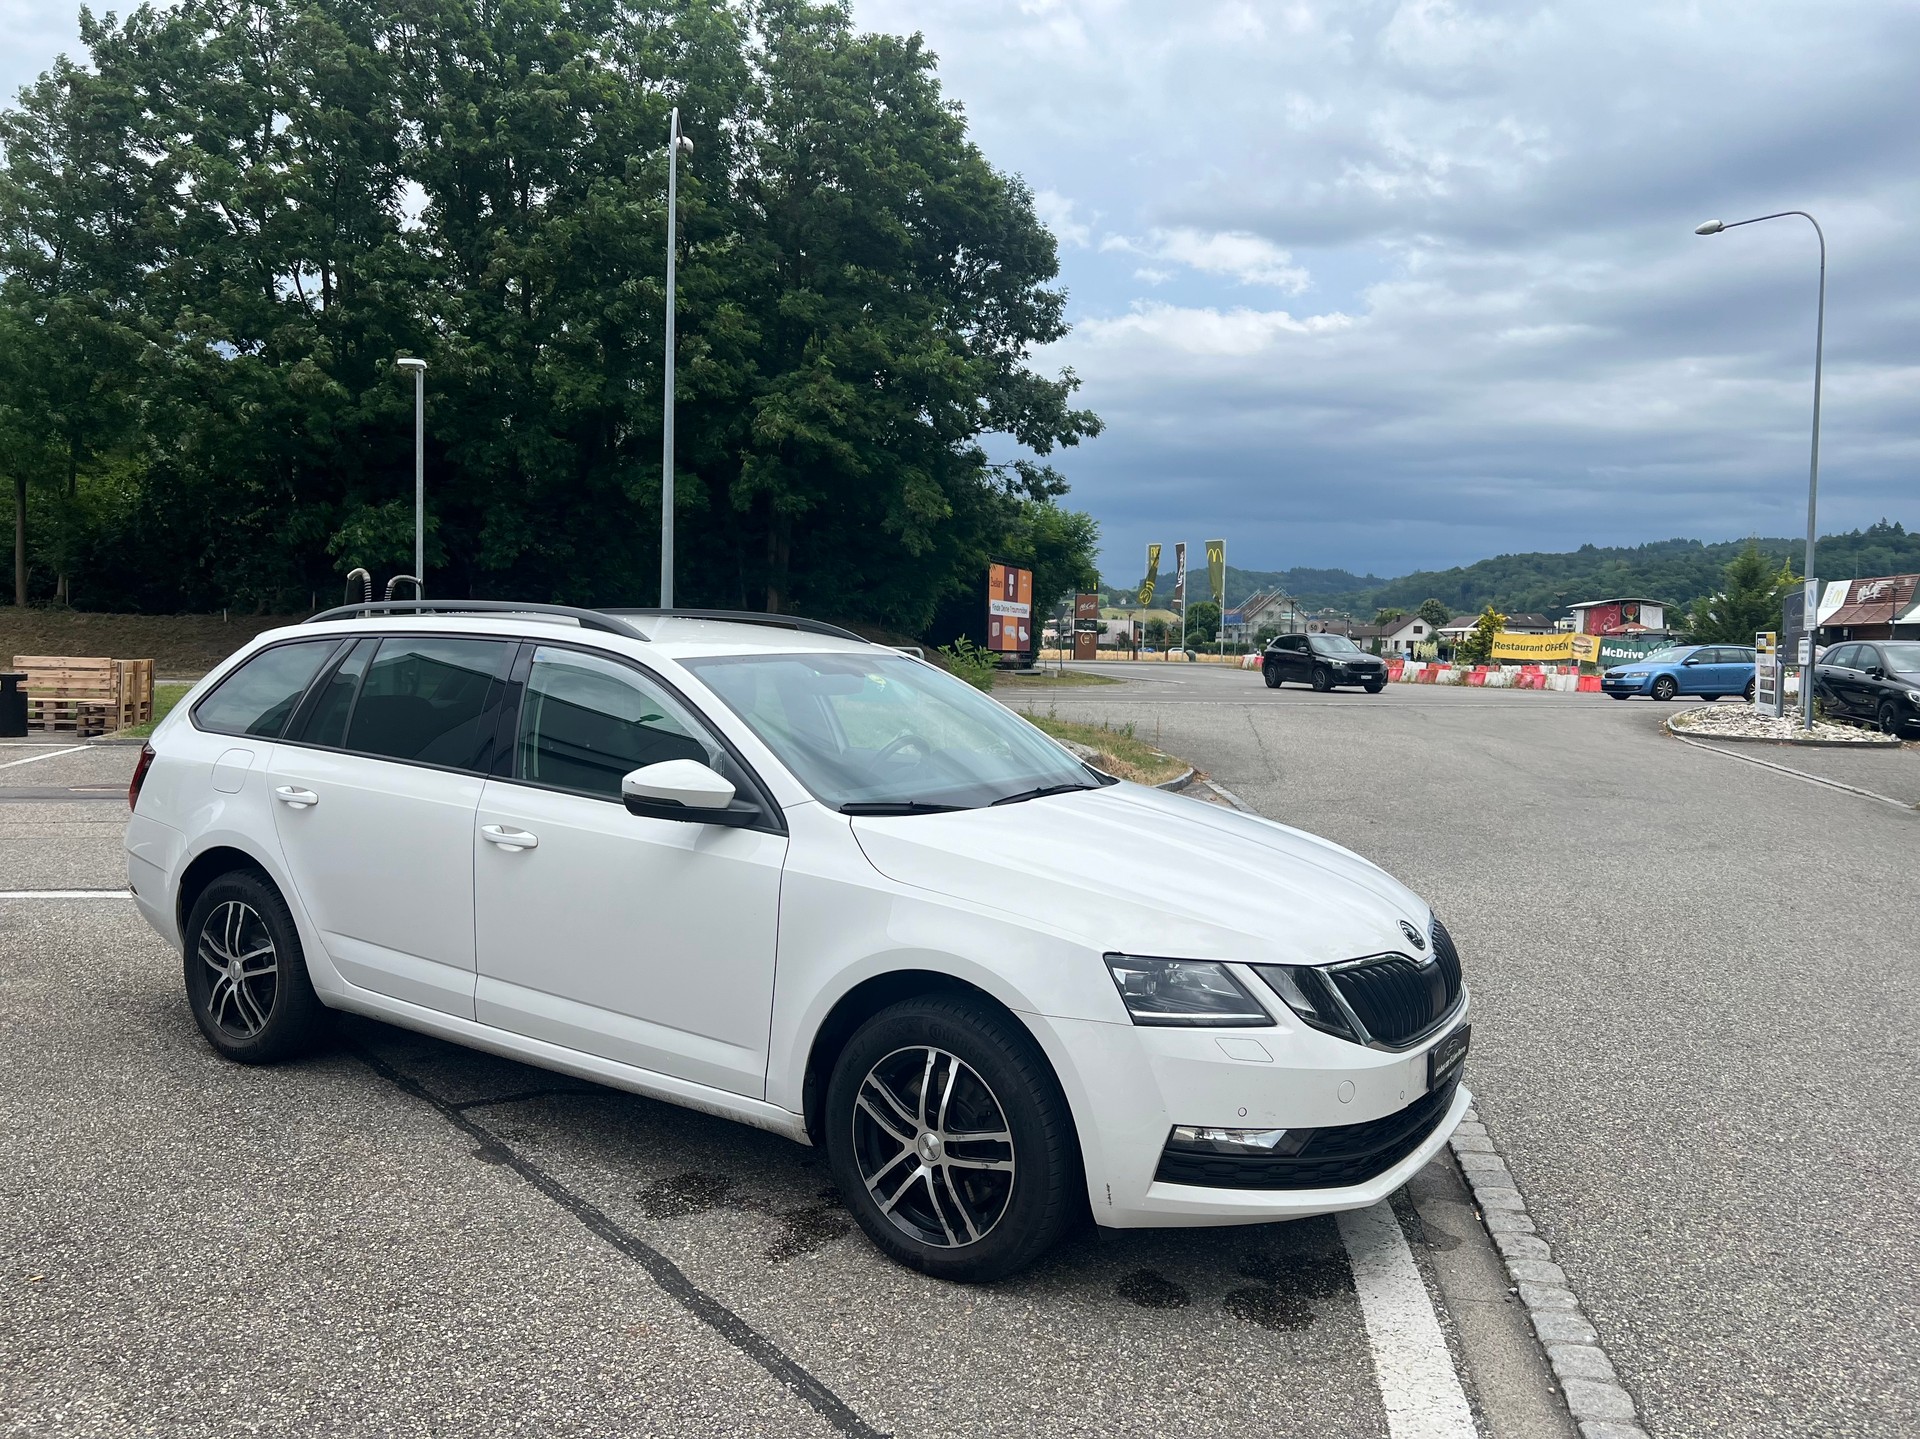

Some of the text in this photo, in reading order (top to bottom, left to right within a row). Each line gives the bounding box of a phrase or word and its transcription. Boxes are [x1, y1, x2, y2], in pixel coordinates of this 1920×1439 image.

[1494, 641, 1569, 652] Restaurant OFFEN
[1602, 646, 1644, 659] McDrive
